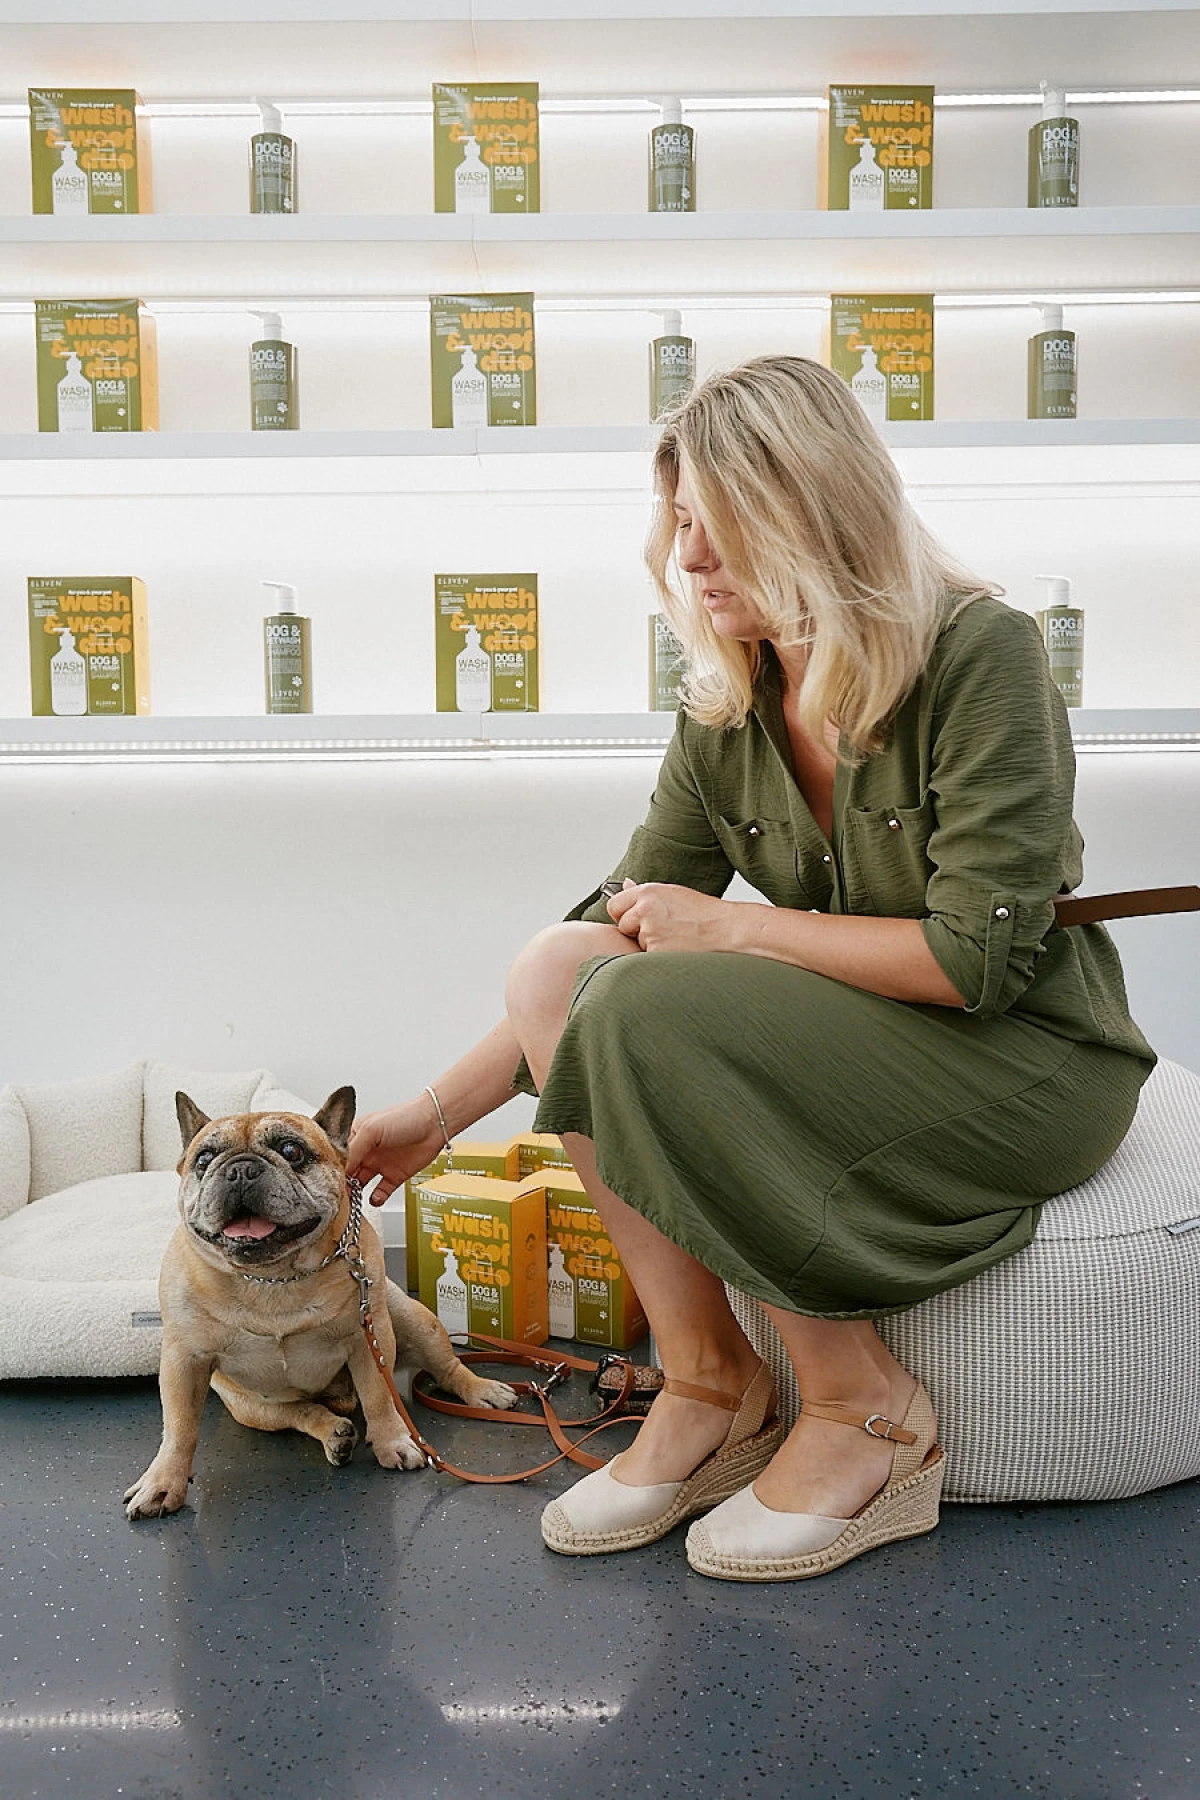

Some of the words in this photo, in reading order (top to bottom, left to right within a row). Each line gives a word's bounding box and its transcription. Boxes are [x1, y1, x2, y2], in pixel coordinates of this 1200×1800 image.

[60, 104, 132, 125] wash
[465, 97, 536, 120] wash
[861, 100, 930, 122] wash
[68, 127, 134, 150] woof
[472, 120, 536, 144] woof
[655, 133, 680, 147] DOG
[868, 124, 931, 147] woof
[1044, 128, 1070, 141] DOG
[81, 148, 134, 169] duo
[256, 142, 281, 155] DOG
[484, 142, 537, 164] duo
[879, 144, 930, 167] duo
[55, 177, 84, 187] WASH
[458, 172, 488, 181] WASH
[852, 174, 881, 183] WASH
[66, 313, 136, 335] wash
[461, 307, 531, 329] wash
[862, 308, 930, 329] wash
[74, 336, 138, 359] woof
[468, 329, 532, 352] woof
[870, 331, 931, 353] woof
[1044, 339, 1069, 352] DOG
[252, 350, 274, 363] DOG
[480, 350, 533, 372] duo
[661, 346, 685, 357] DOG
[880, 350, 931, 372] duo
[86, 357, 138, 378] duo
[60, 386, 89, 396] WASH
[455, 380, 484, 389] WASH
[854, 380, 884, 389] WASH
[58, 591, 129, 612] wash
[466, 588, 536, 609] wash
[68, 612, 131, 635] woof
[266, 625, 288, 637] DOG
[473, 610, 536, 632] woof
[1048, 617, 1076, 630] DOG
[80, 633, 132, 654] duo
[484, 630, 536, 651] duo
[53, 662, 82, 671] WASH
[459, 659, 488, 668] WASH
[444, 1213, 508, 1241] wash
[431, 1232, 448, 1255] &
[450, 1237, 510, 1267] woof
[462, 1259, 510, 1287] duo
[568, 1254, 620, 1281] duo
[439, 1284, 465, 1296] WASH
[472, 1284, 490, 1297] DOG
[491, 1287, 499, 1299] &
[578, 1279, 599, 1290] DOG
[600, 1281, 608, 1292] &
